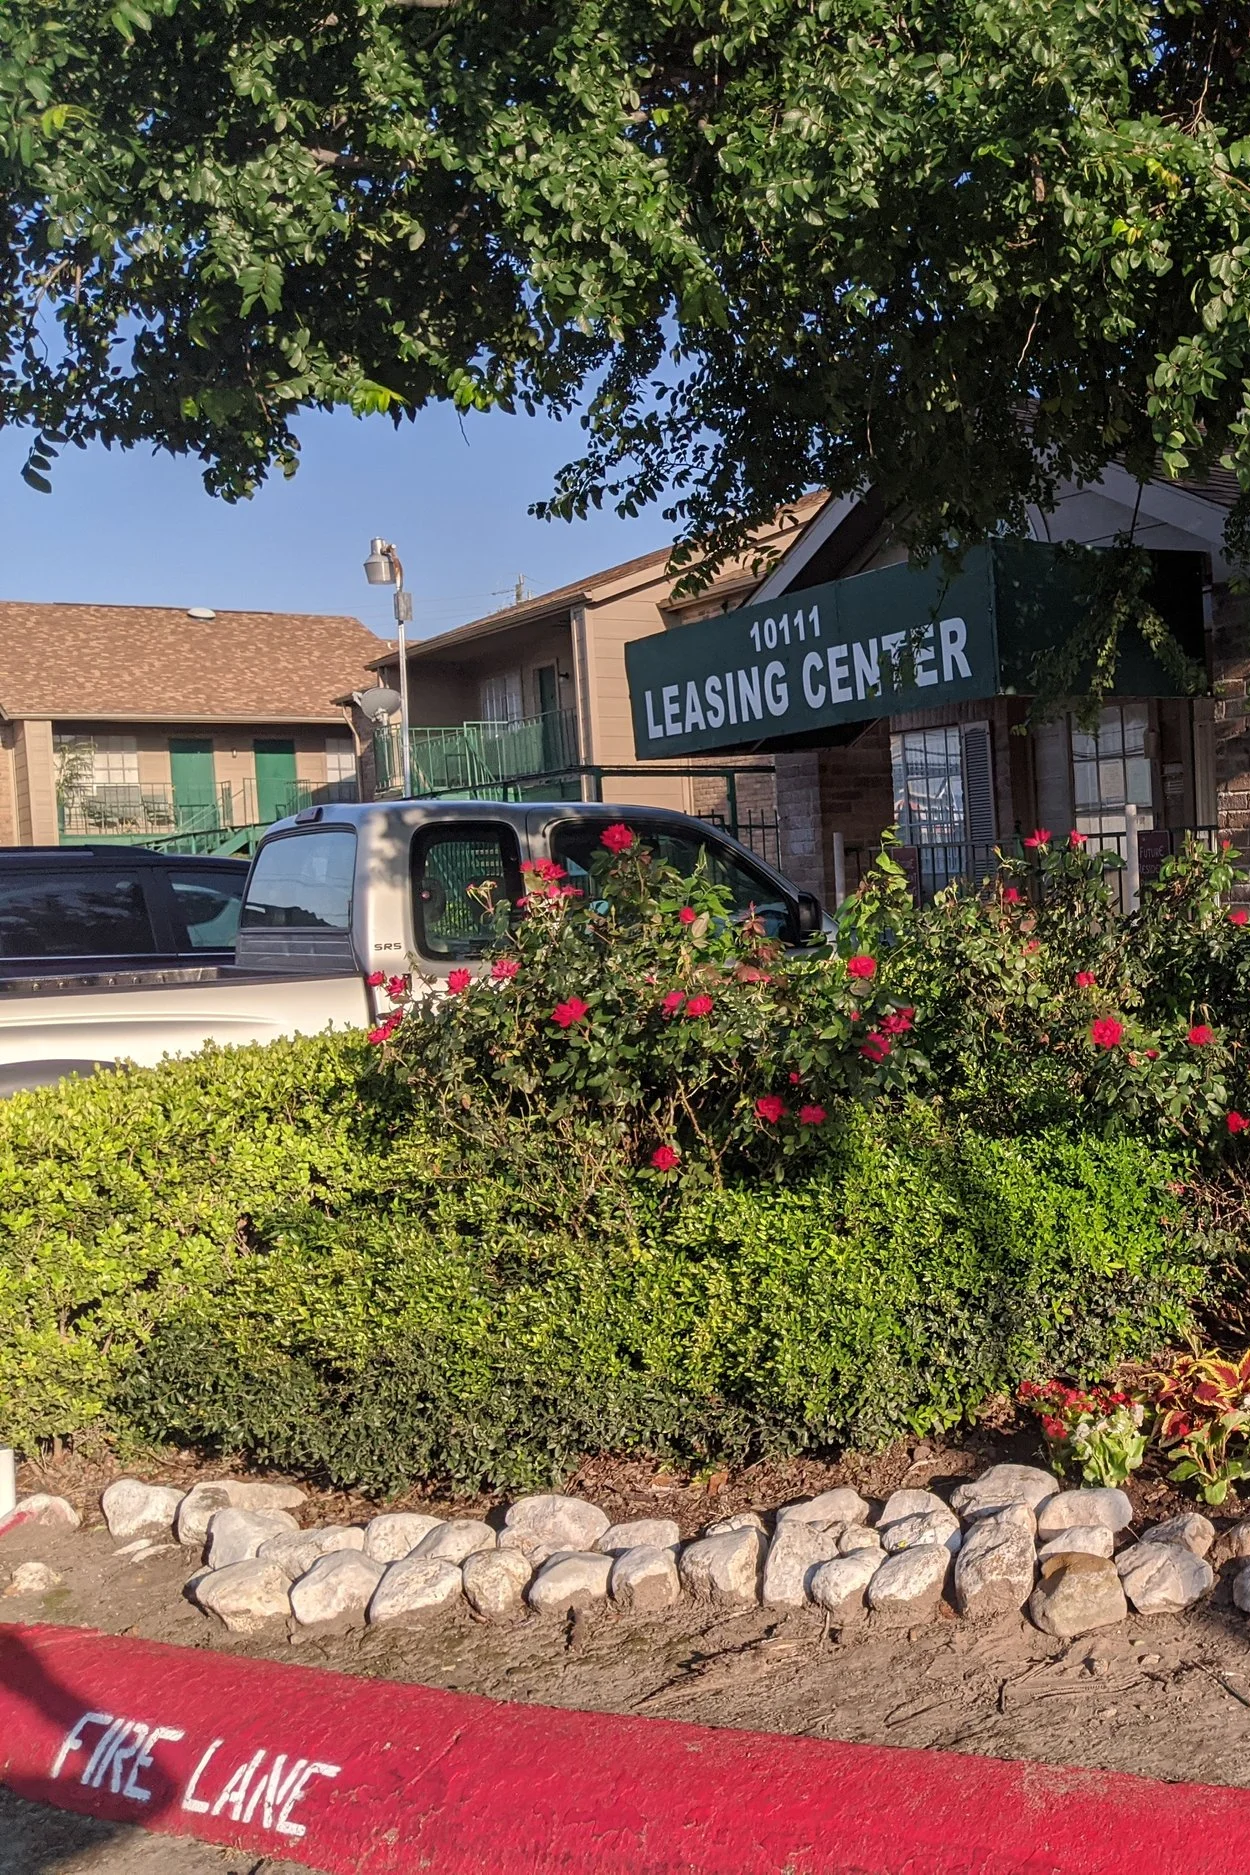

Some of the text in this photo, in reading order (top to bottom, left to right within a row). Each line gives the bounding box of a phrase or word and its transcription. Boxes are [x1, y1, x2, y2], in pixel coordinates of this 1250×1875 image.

[645, 616, 972, 739] LEASING CENTER
[749, 605, 821, 653] 10111
[51, 1711, 342, 1837] FIRE LANE
